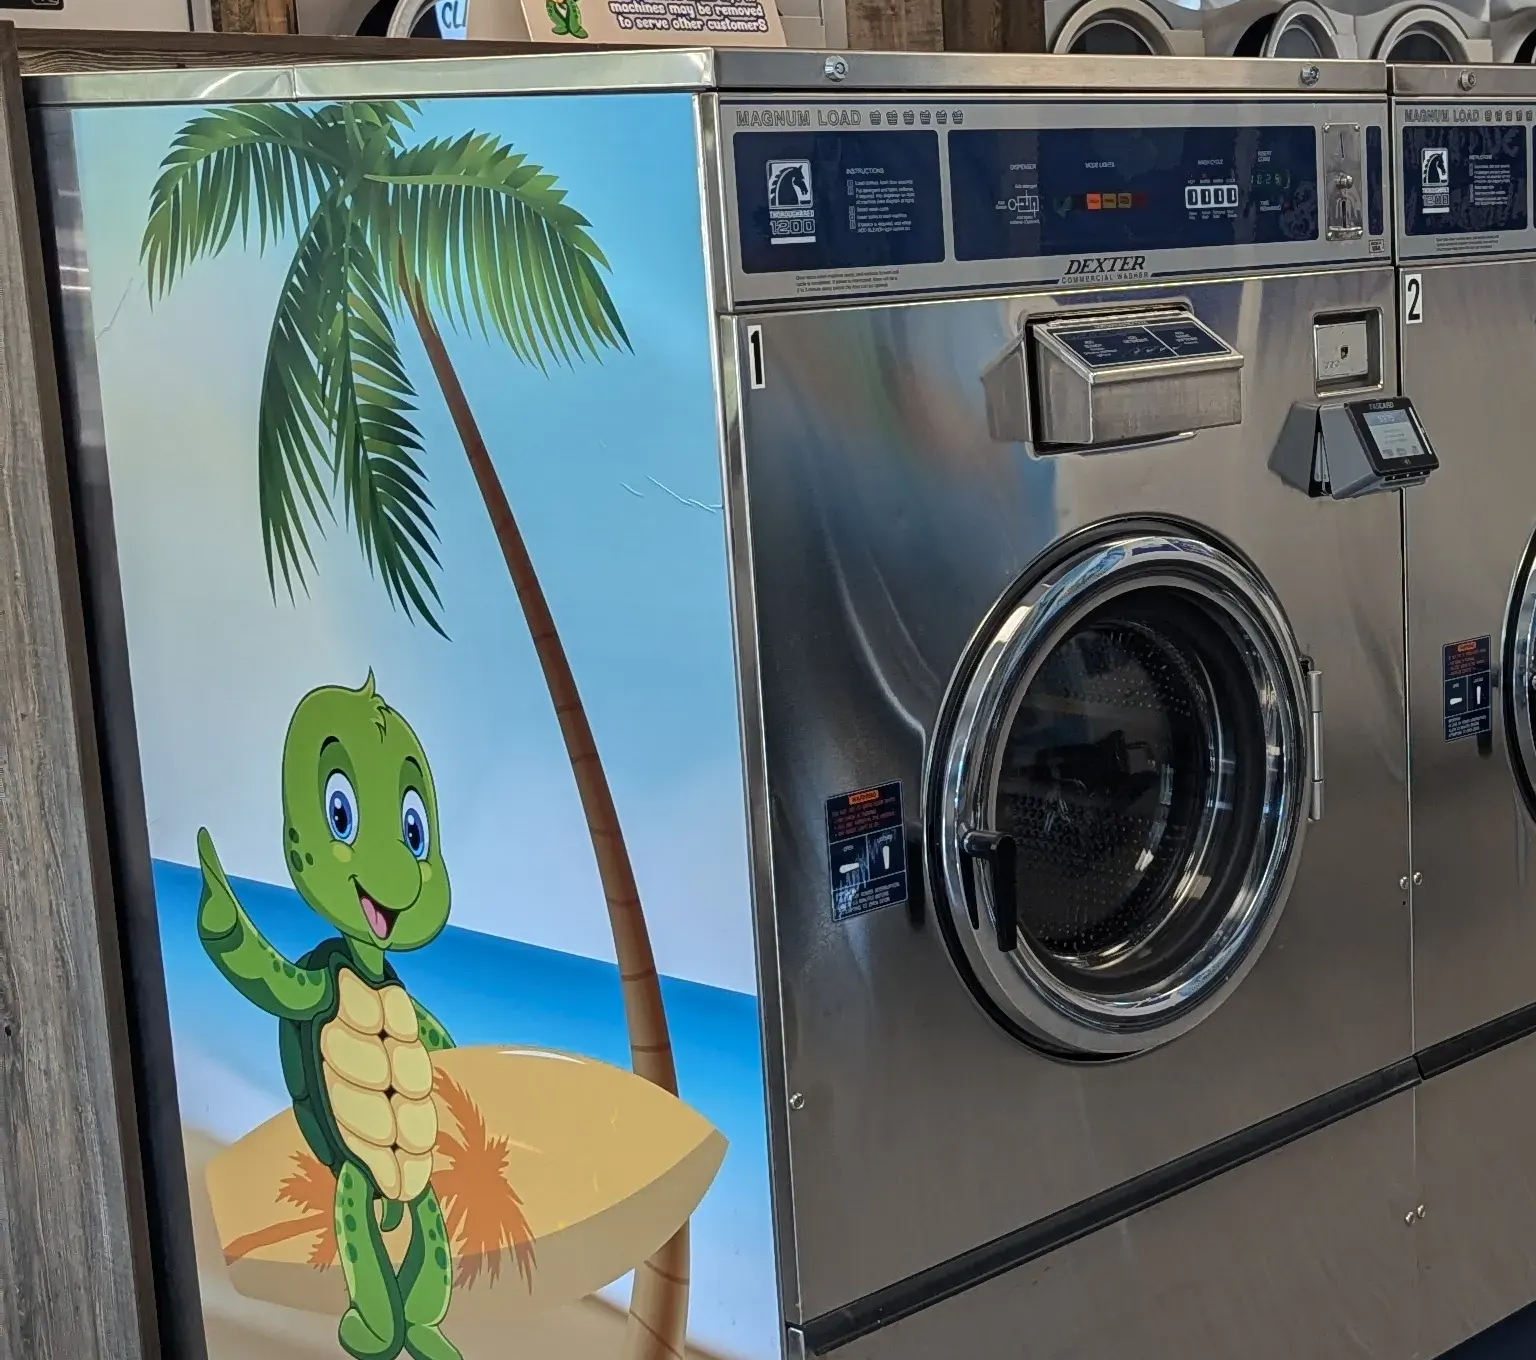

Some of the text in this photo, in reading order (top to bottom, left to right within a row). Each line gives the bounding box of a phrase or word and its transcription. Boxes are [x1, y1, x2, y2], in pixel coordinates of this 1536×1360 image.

[609, 0, 764, 19] machines may be removed
[618, 14, 632, 28] to
[636, 19, 669, 29] serve
[673, 17, 704, 30] other
[736, 110, 862, 126] MAGNUM LOAD
[1405, 109, 1480, 122] MAGNUM LOAD
[769, 220, 815, 235] 1200
[1064, 256, 1146, 275] DEXTER
[1062, 275, 1113, 284] COMMERCIAL
[1408, 278, 1421, 320] 2
[751, 330, 762, 385] 1
